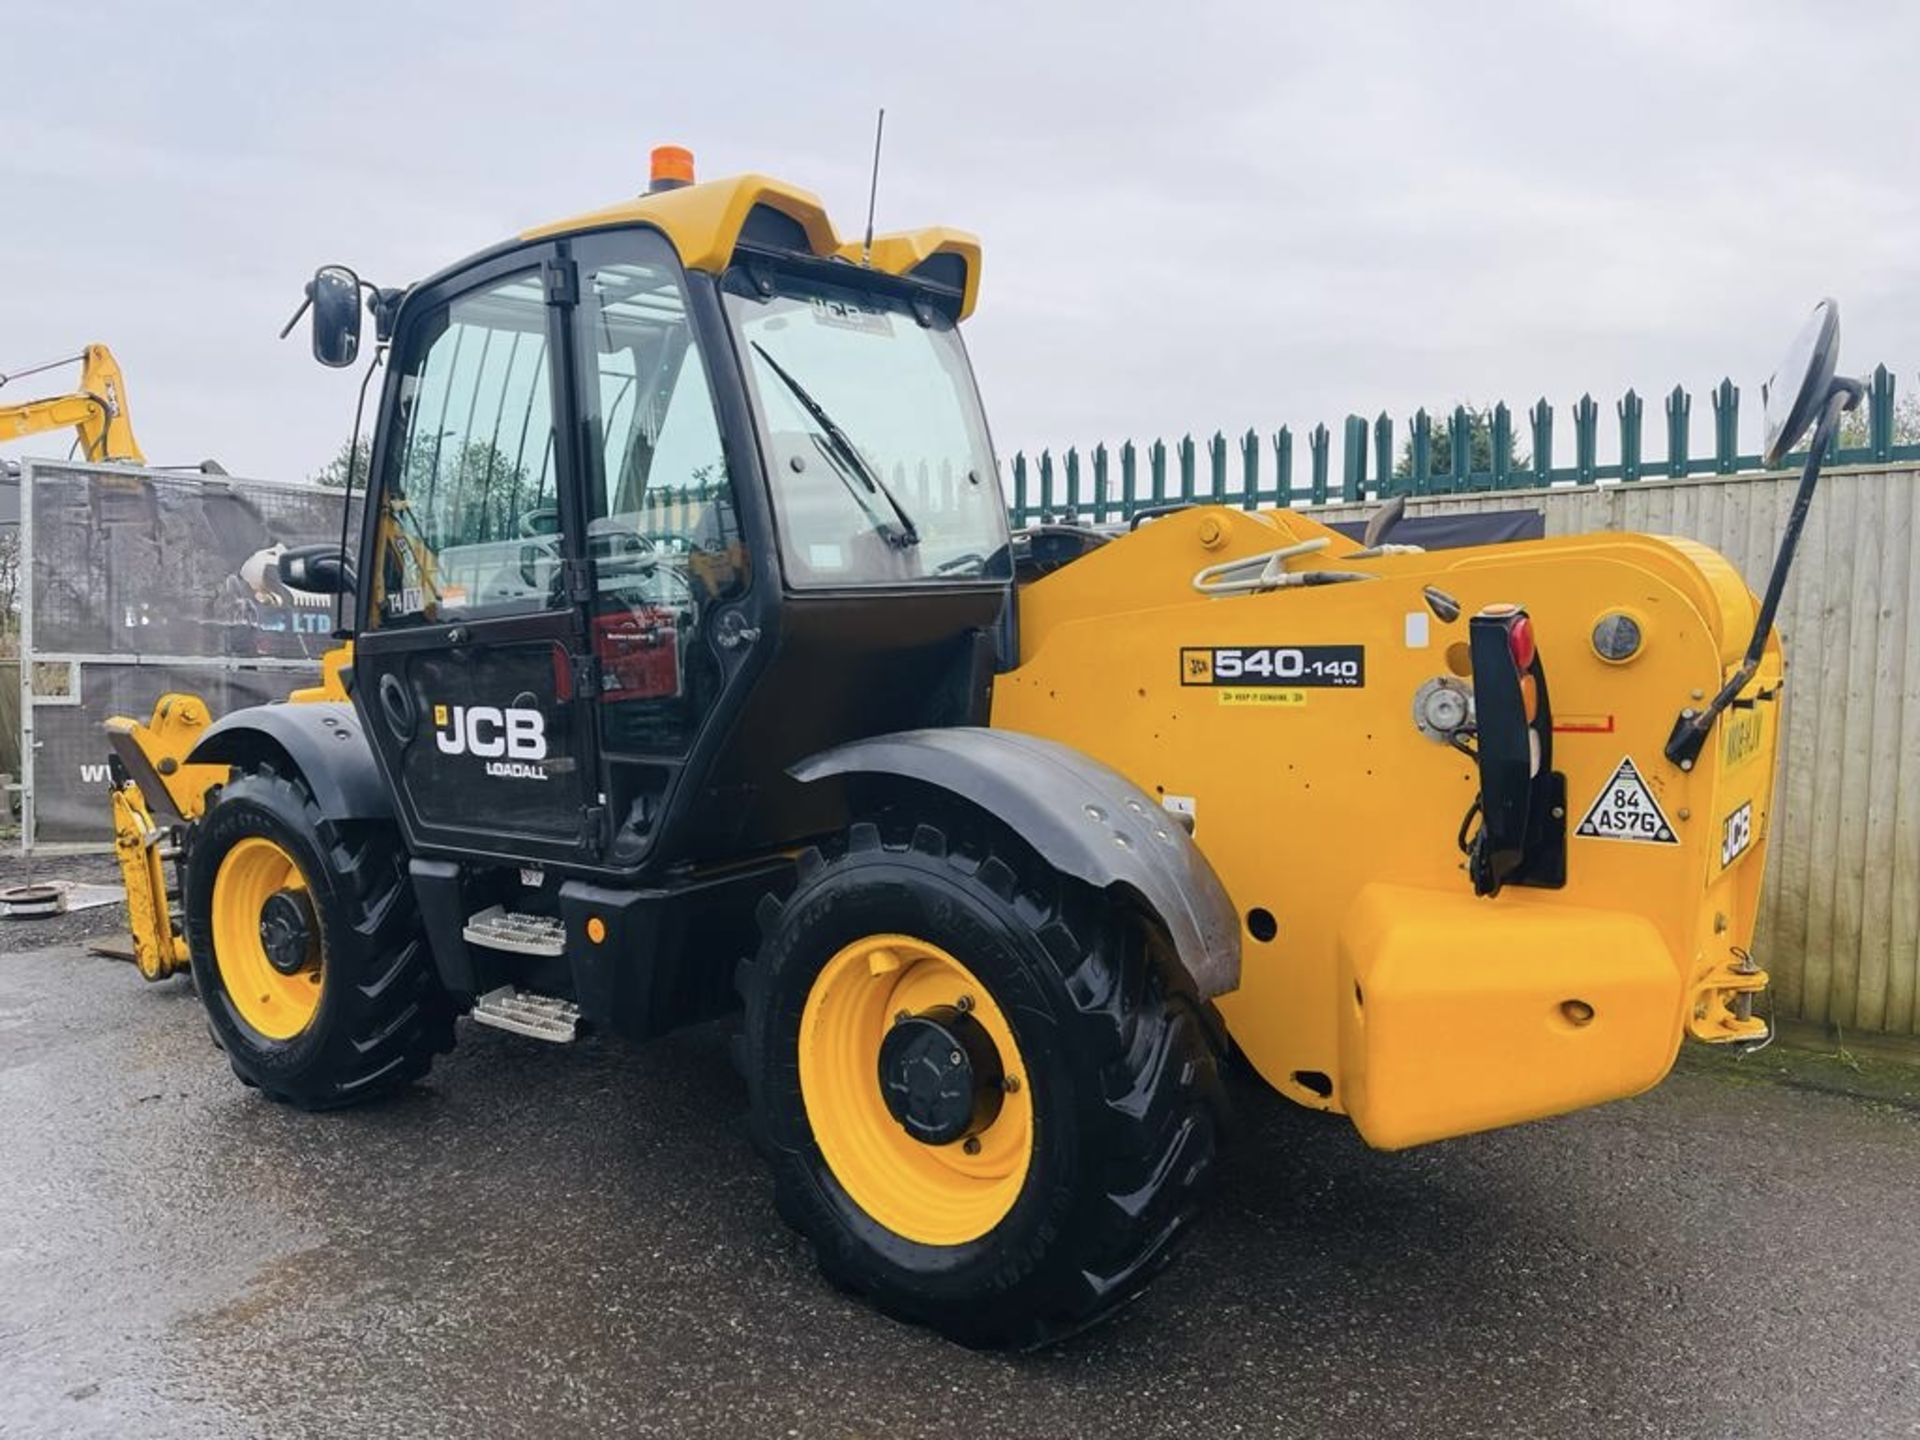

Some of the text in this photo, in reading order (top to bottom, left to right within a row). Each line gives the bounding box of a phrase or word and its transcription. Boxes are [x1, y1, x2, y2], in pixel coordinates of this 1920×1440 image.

[292, 612, 331, 633] LTD
[1215, 649, 1358, 677] 540-140
[435, 705, 547, 760] JCB
[486, 762, 548, 780] LOADALL
[1614, 788, 1640, 809] 84
[1600, 809, 1655, 833] AS7G
[1722, 803, 1751, 866] JCB
